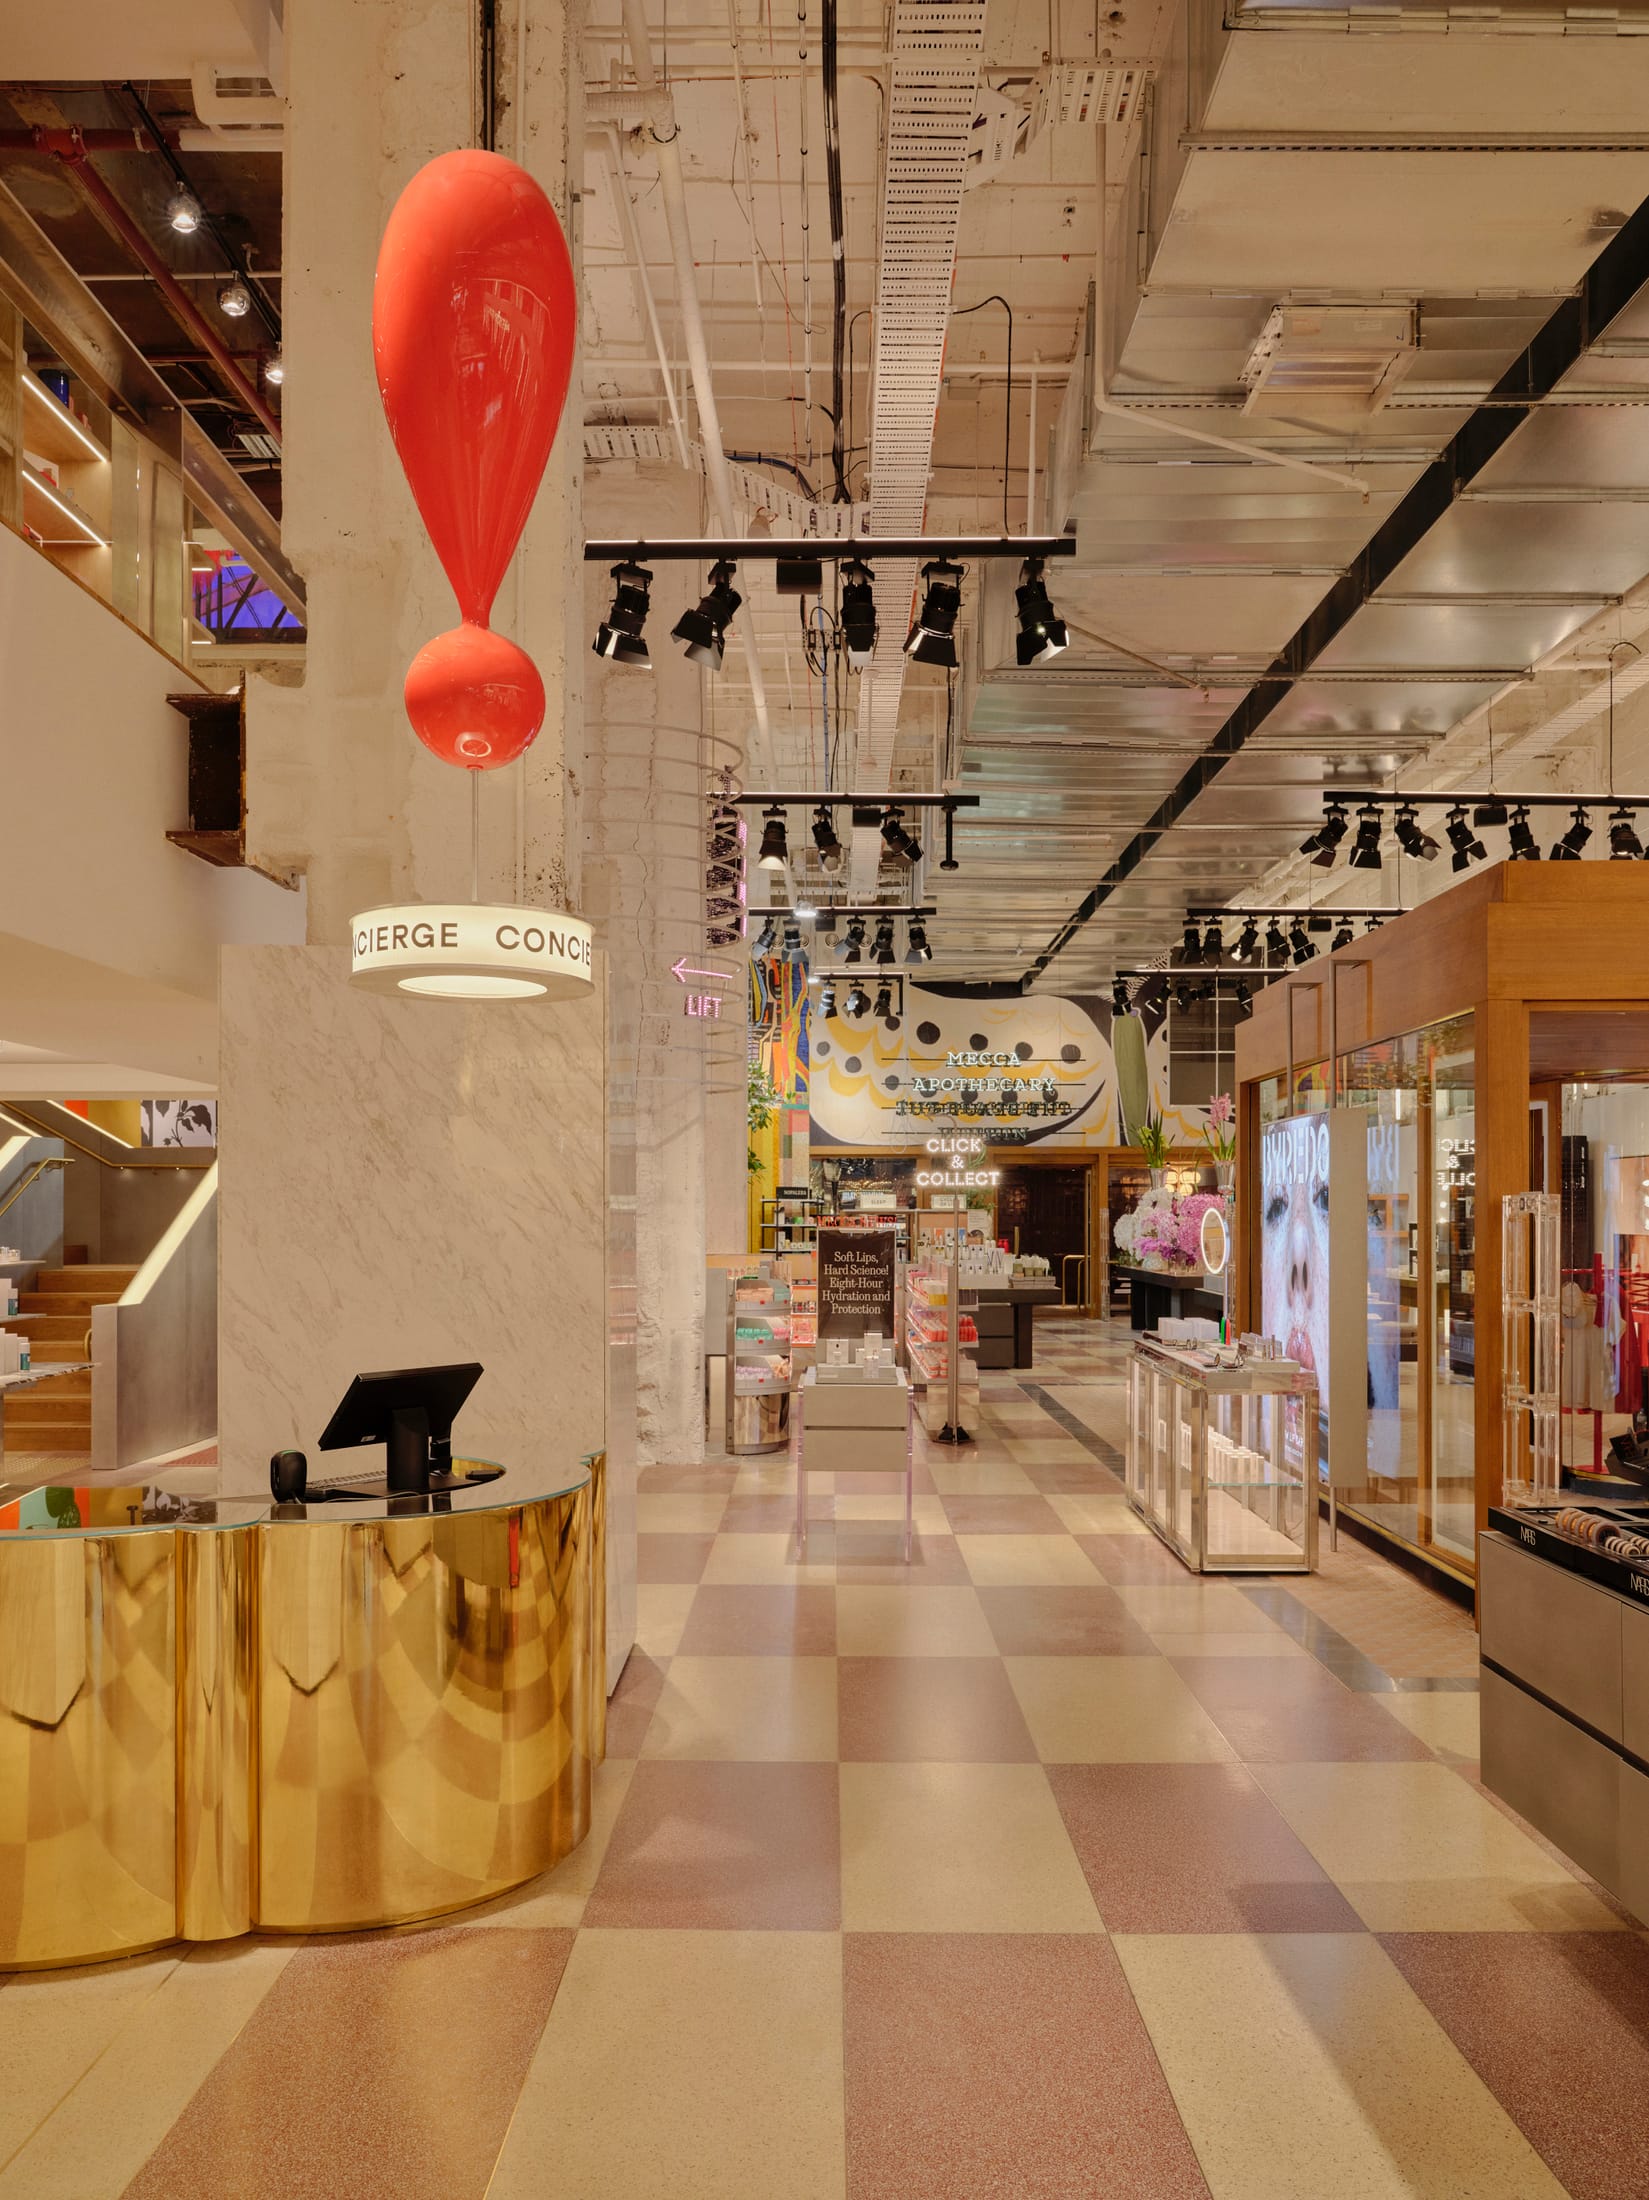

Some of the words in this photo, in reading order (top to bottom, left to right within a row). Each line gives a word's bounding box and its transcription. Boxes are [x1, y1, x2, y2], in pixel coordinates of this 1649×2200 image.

[687, 995, 721, 1018] LIFT
[945, 1050, 1022, 1069] MECCA
[912, 1077, 1056, 1093] APOTHECARY
[926, 1137, 981, 1154] CLICK
[1262, 1122, 1330, 1185] BYREDO
[951, 1154, 965, 1170] &
[915, 1171, 1000, 1187] COLLECT
[834, 1251, 855, 1263] Soft
[856, 1251, 879, 1265] Lips,
[824, 1264, 849, 1276] Hard
[850, 1264, 889, 1276] Science!
[830, 1277, 884, 1291] Eight-Hour
[822, 1290, 872, 1304] Hydration
[872, 1290, 891, 1302] and
[831, 1303, 881, 1315] Protection
[1520, 1525, 1536, 1546] NARS
